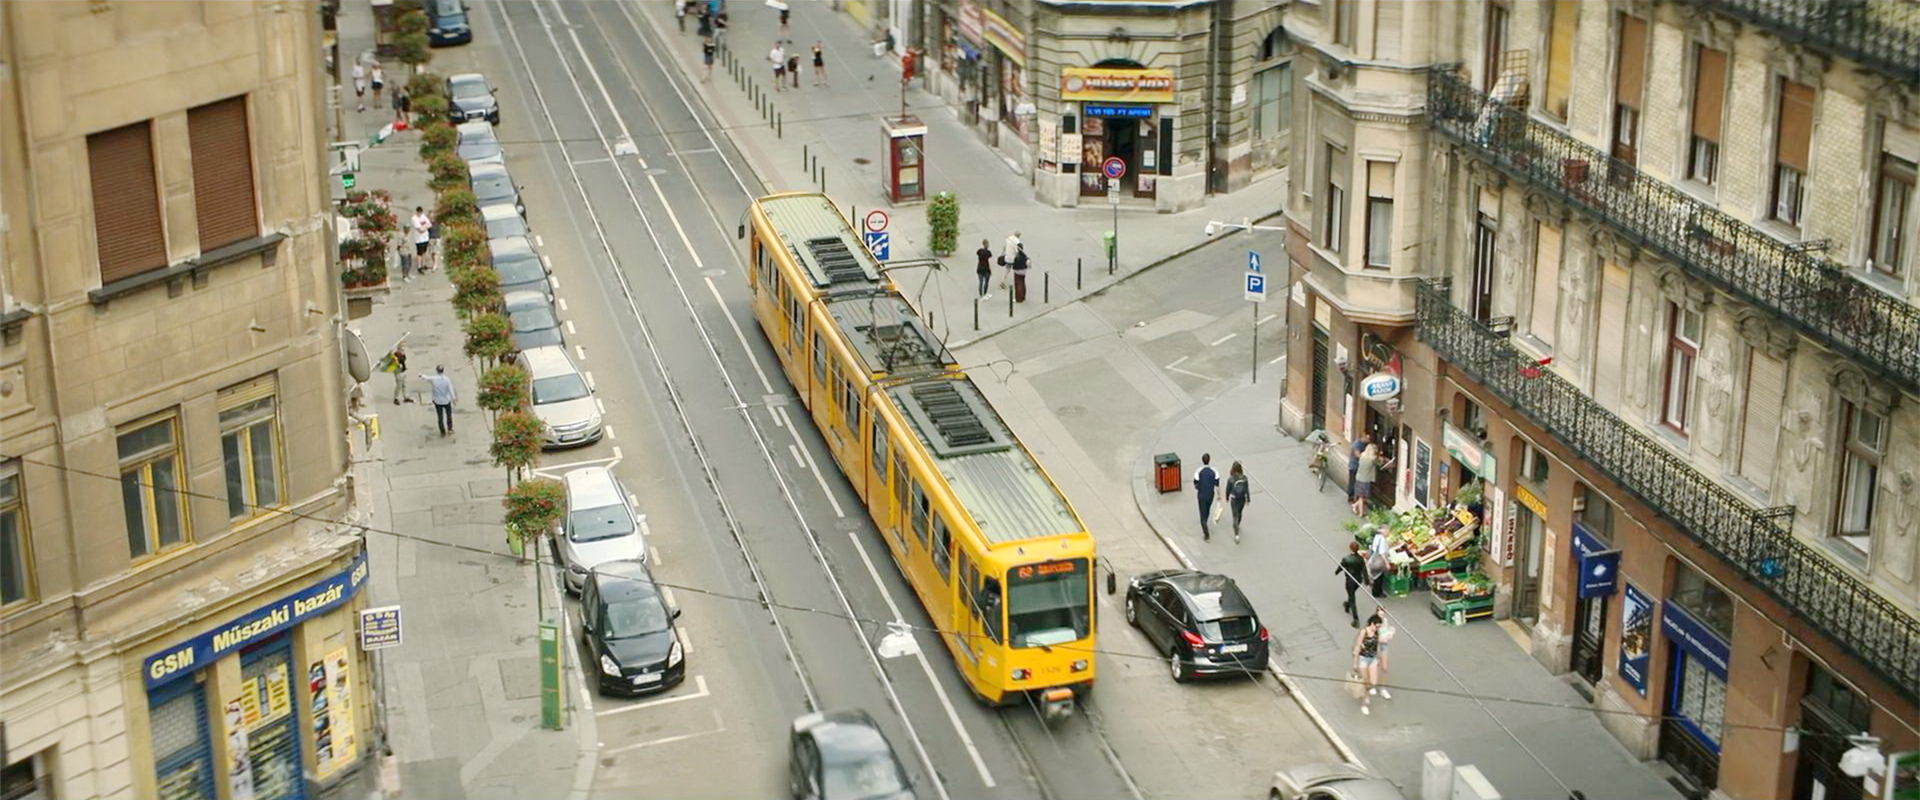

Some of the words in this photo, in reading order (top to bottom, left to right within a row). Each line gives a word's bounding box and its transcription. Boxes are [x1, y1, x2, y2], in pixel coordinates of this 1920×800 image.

[1249, 277, 1261, 290] P
[351, 561, 367, 588] GSM
[212, 605, 289, 653] Műszaki
[294, 583, 344, 617] bazár
[150, 647, 194, 679] GSM
